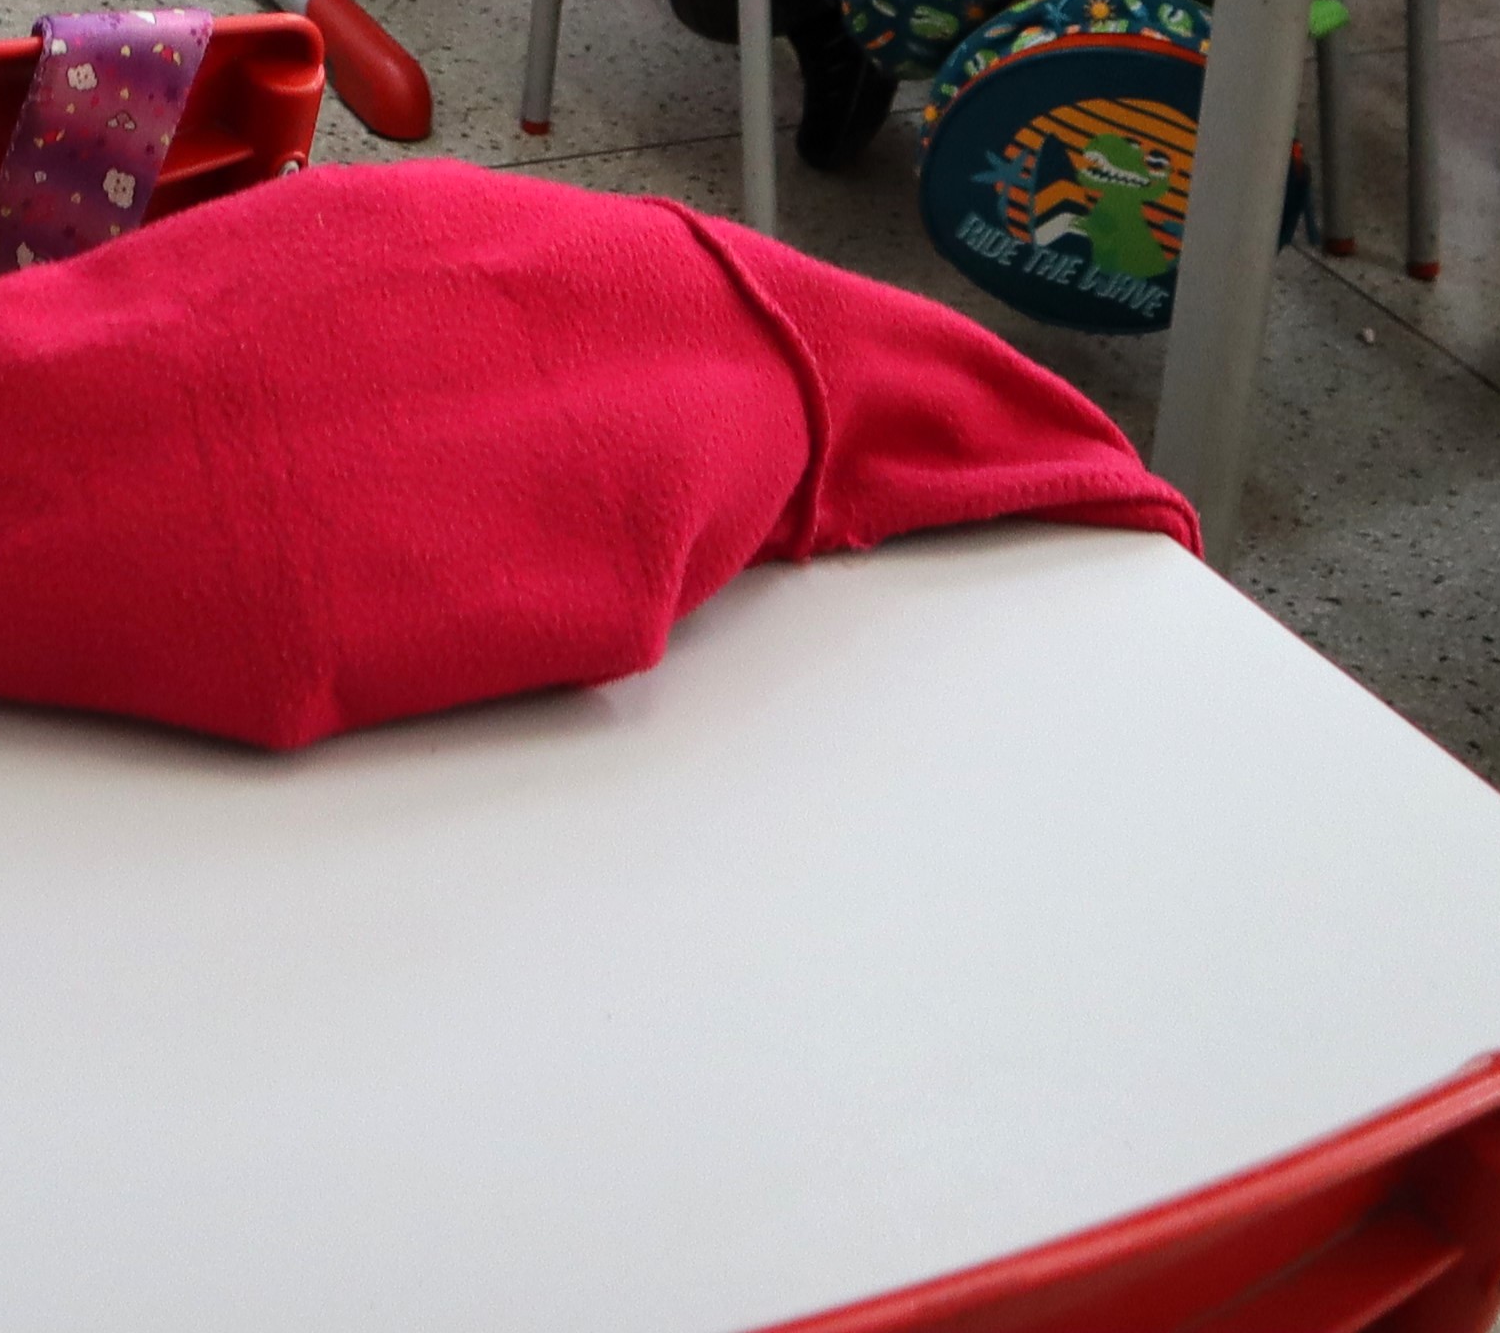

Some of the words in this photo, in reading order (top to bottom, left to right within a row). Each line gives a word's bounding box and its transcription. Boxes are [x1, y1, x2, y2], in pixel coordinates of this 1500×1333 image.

[955, 213, 1022, 266] RIDE
[1023, 245, 1083, 285] THE
[1078, 264, 1170, 318] WAVE
